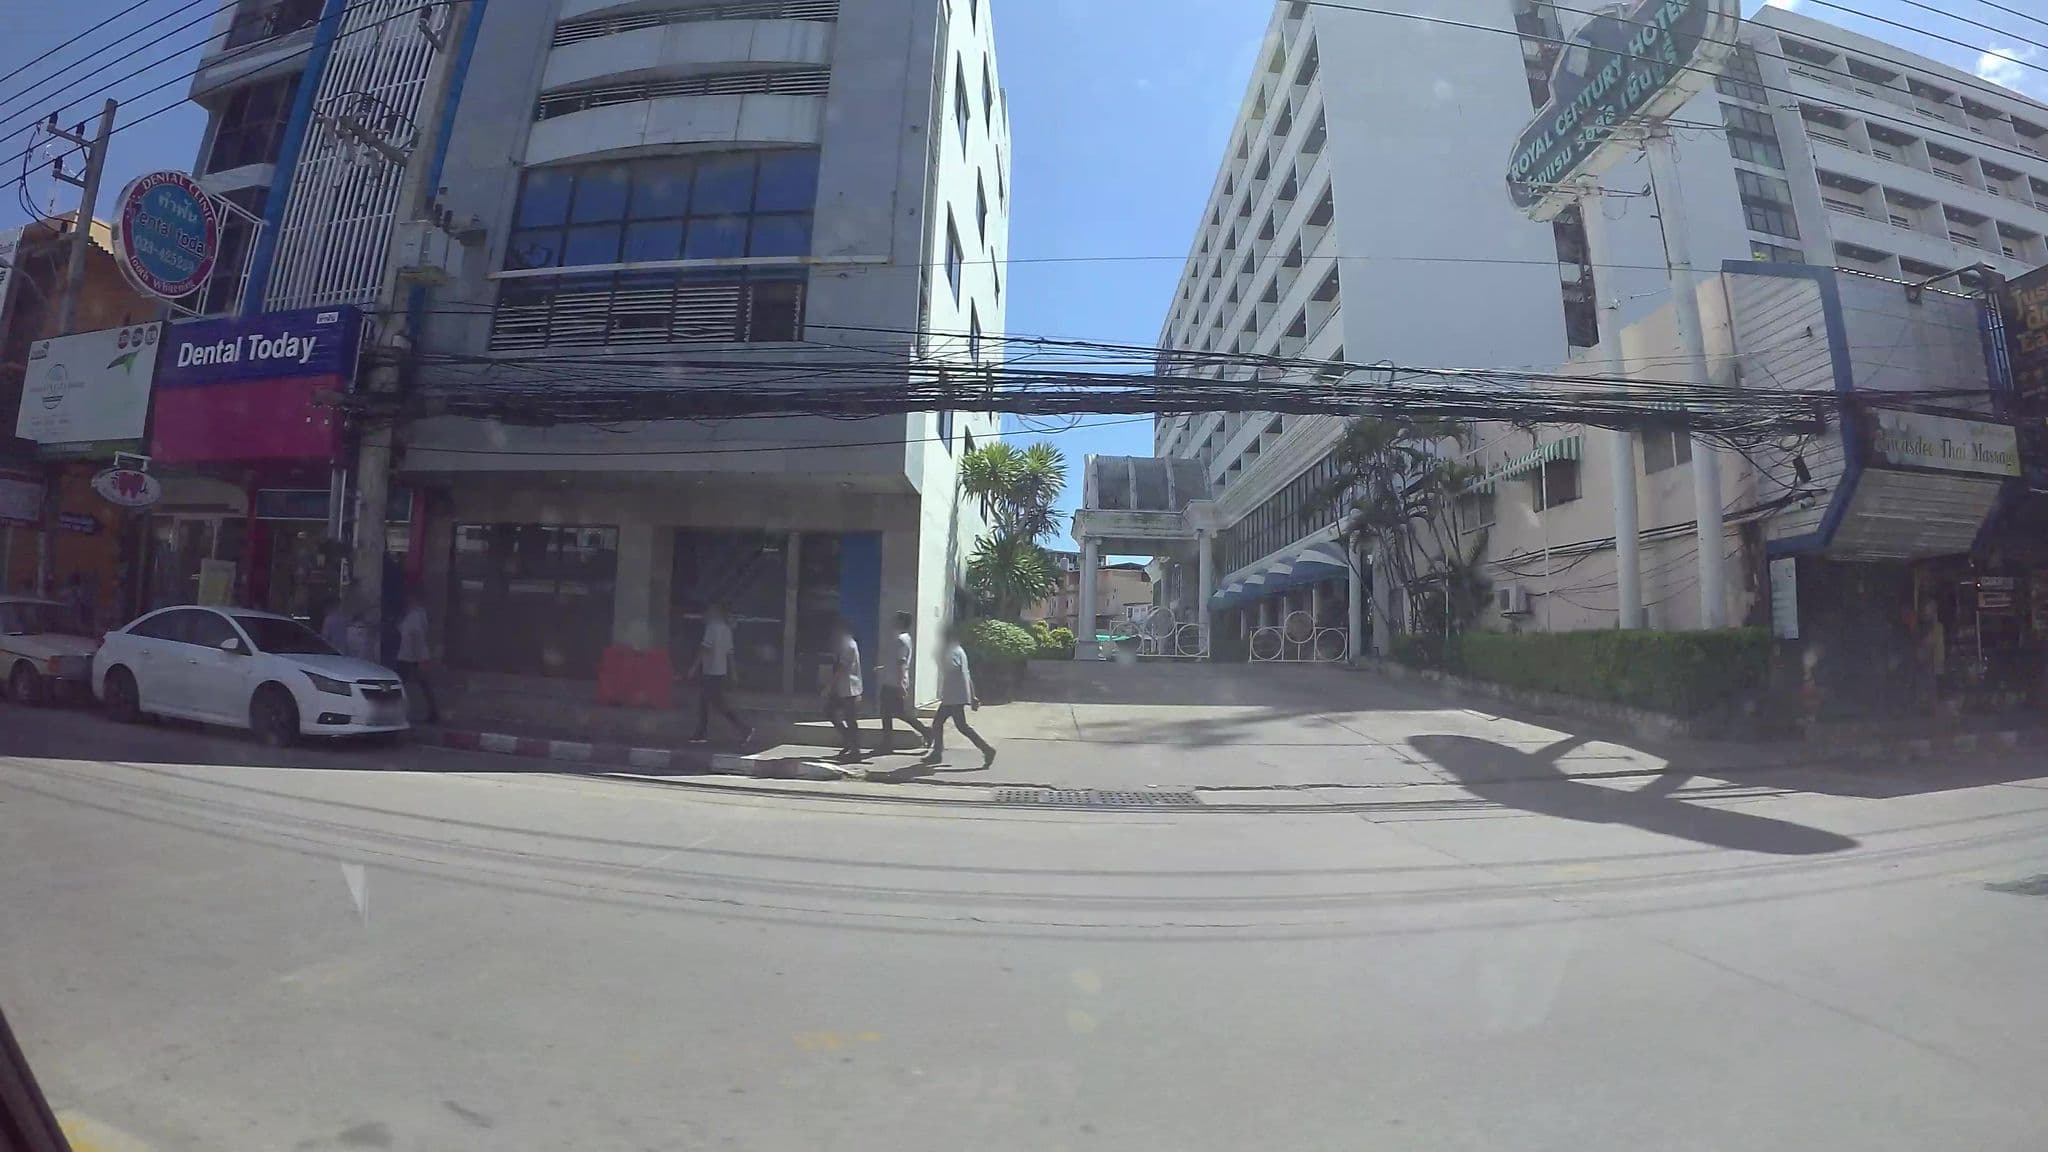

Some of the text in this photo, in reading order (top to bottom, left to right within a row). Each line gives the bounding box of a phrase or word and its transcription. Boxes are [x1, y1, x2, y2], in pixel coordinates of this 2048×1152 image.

[1511, 130, 1553, 181] ROYAL
[1555, 54, 1622, 136] CENTURY
[142, 171, 214, 222] DENTAL CLINIC
[177, 331, 317, 367] Dental Today
[1941, 438, 1967, 460] Thai
